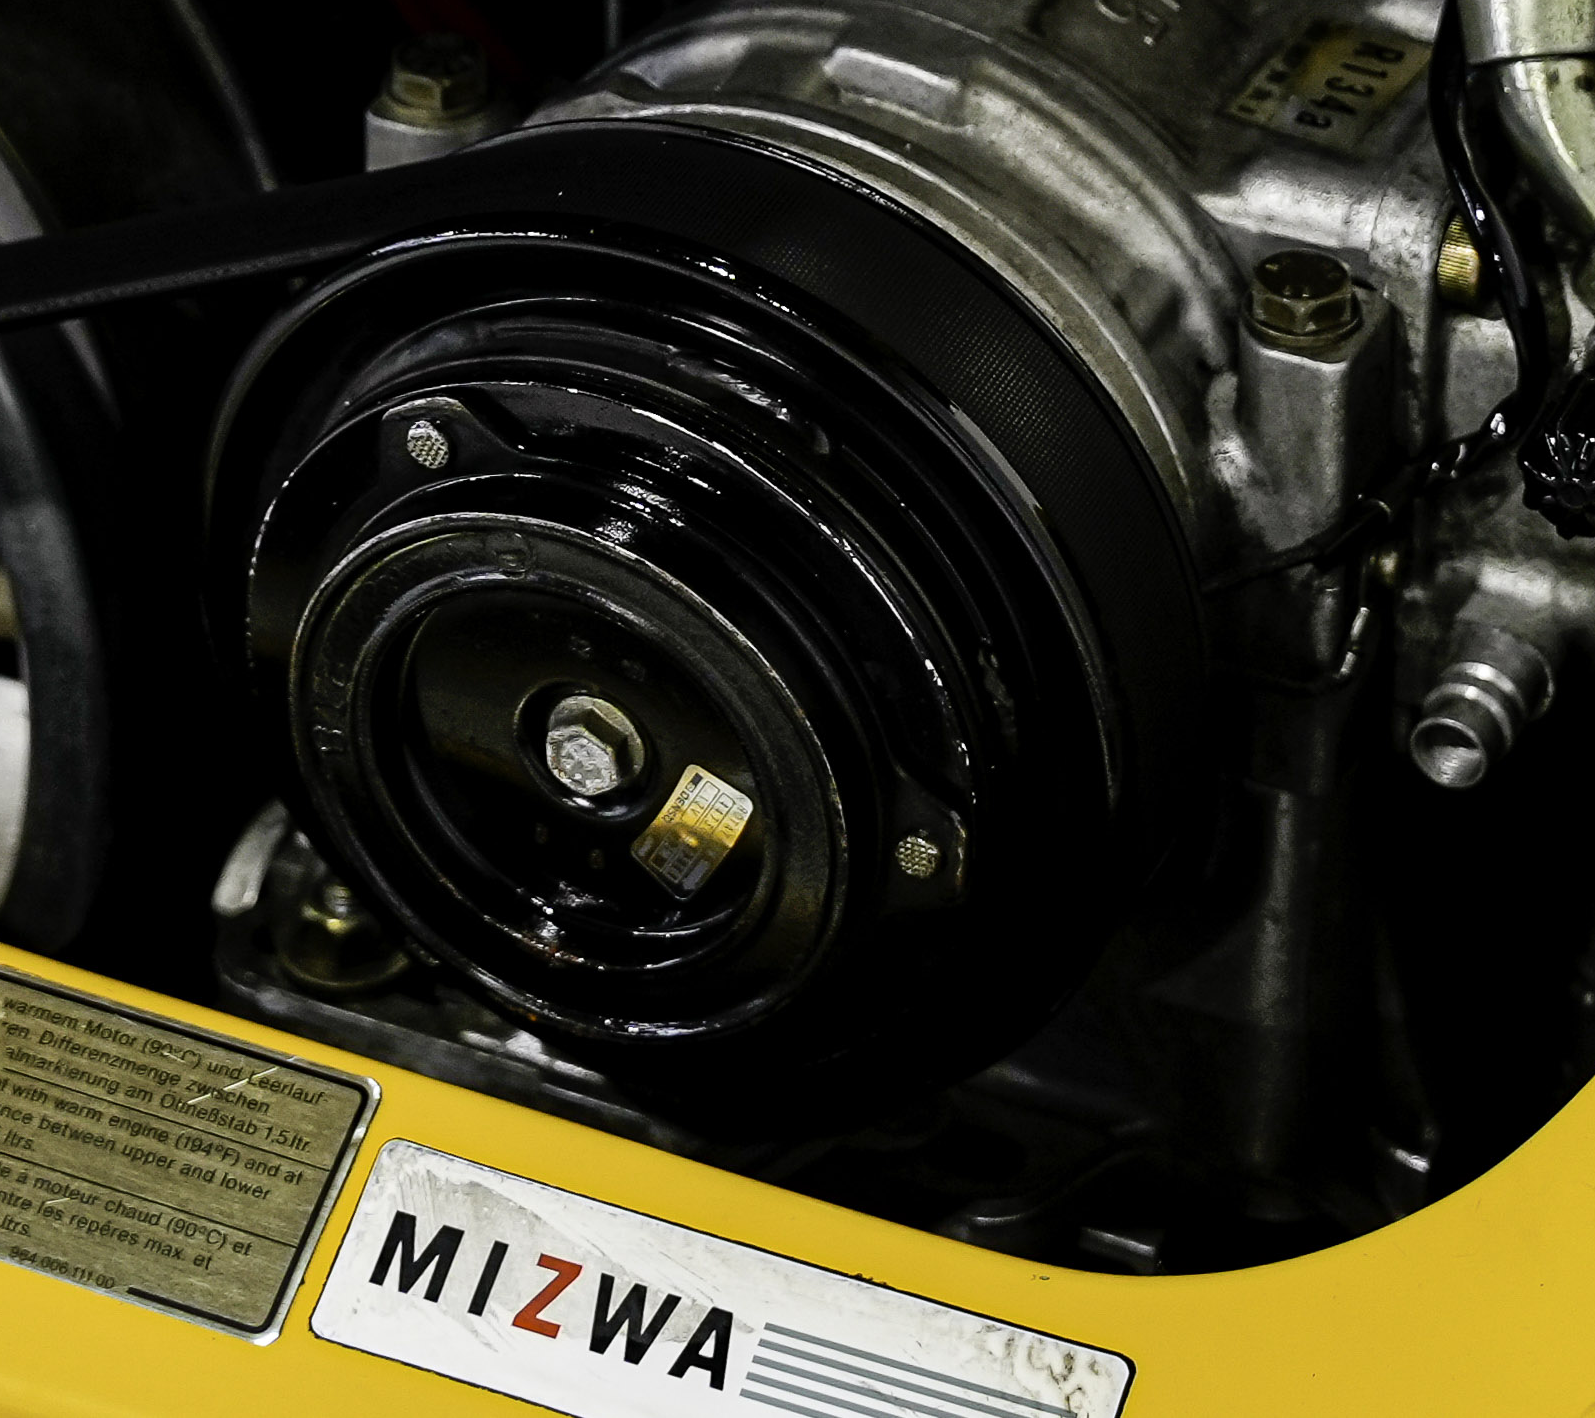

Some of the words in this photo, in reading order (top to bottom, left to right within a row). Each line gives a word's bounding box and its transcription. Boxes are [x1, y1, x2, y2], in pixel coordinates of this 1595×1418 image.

[1296, 41, 1405, 129] R134a
[2, 995, 81, 1030] warmem
[81, 1018, 139, 1048] Motor
[205, 1057, 244, 1081] und
[36, 1030, 184, 1089] Differenzmenge
[183, 1078, 272, 1116] zwischen
[9, 1080, 50, 1105] with
[51, 1097, 104, 1123] warm
[105, 1113, 171, 1146] engine
[242, 1154, 282, 1178] and
[282, 1166, 304, 1185] at
[122, 1084, 155, 1104] am
[36, 1113, 119, 1152] between
[118, 1143, 177, 1175] upper
[178, 1159, 218, 1184] and
[218, 1172, 273, 1201] lower
[31, 1174, 101, 1208] moteur
[102, 1196, 164, 1227] chaud
[230, 1237, 254, 1257] et
[35, 1199, 67, 1222] les
[190, 1250, 213, 1271] et
[369, 1210, 734, 1391] MIZWA
